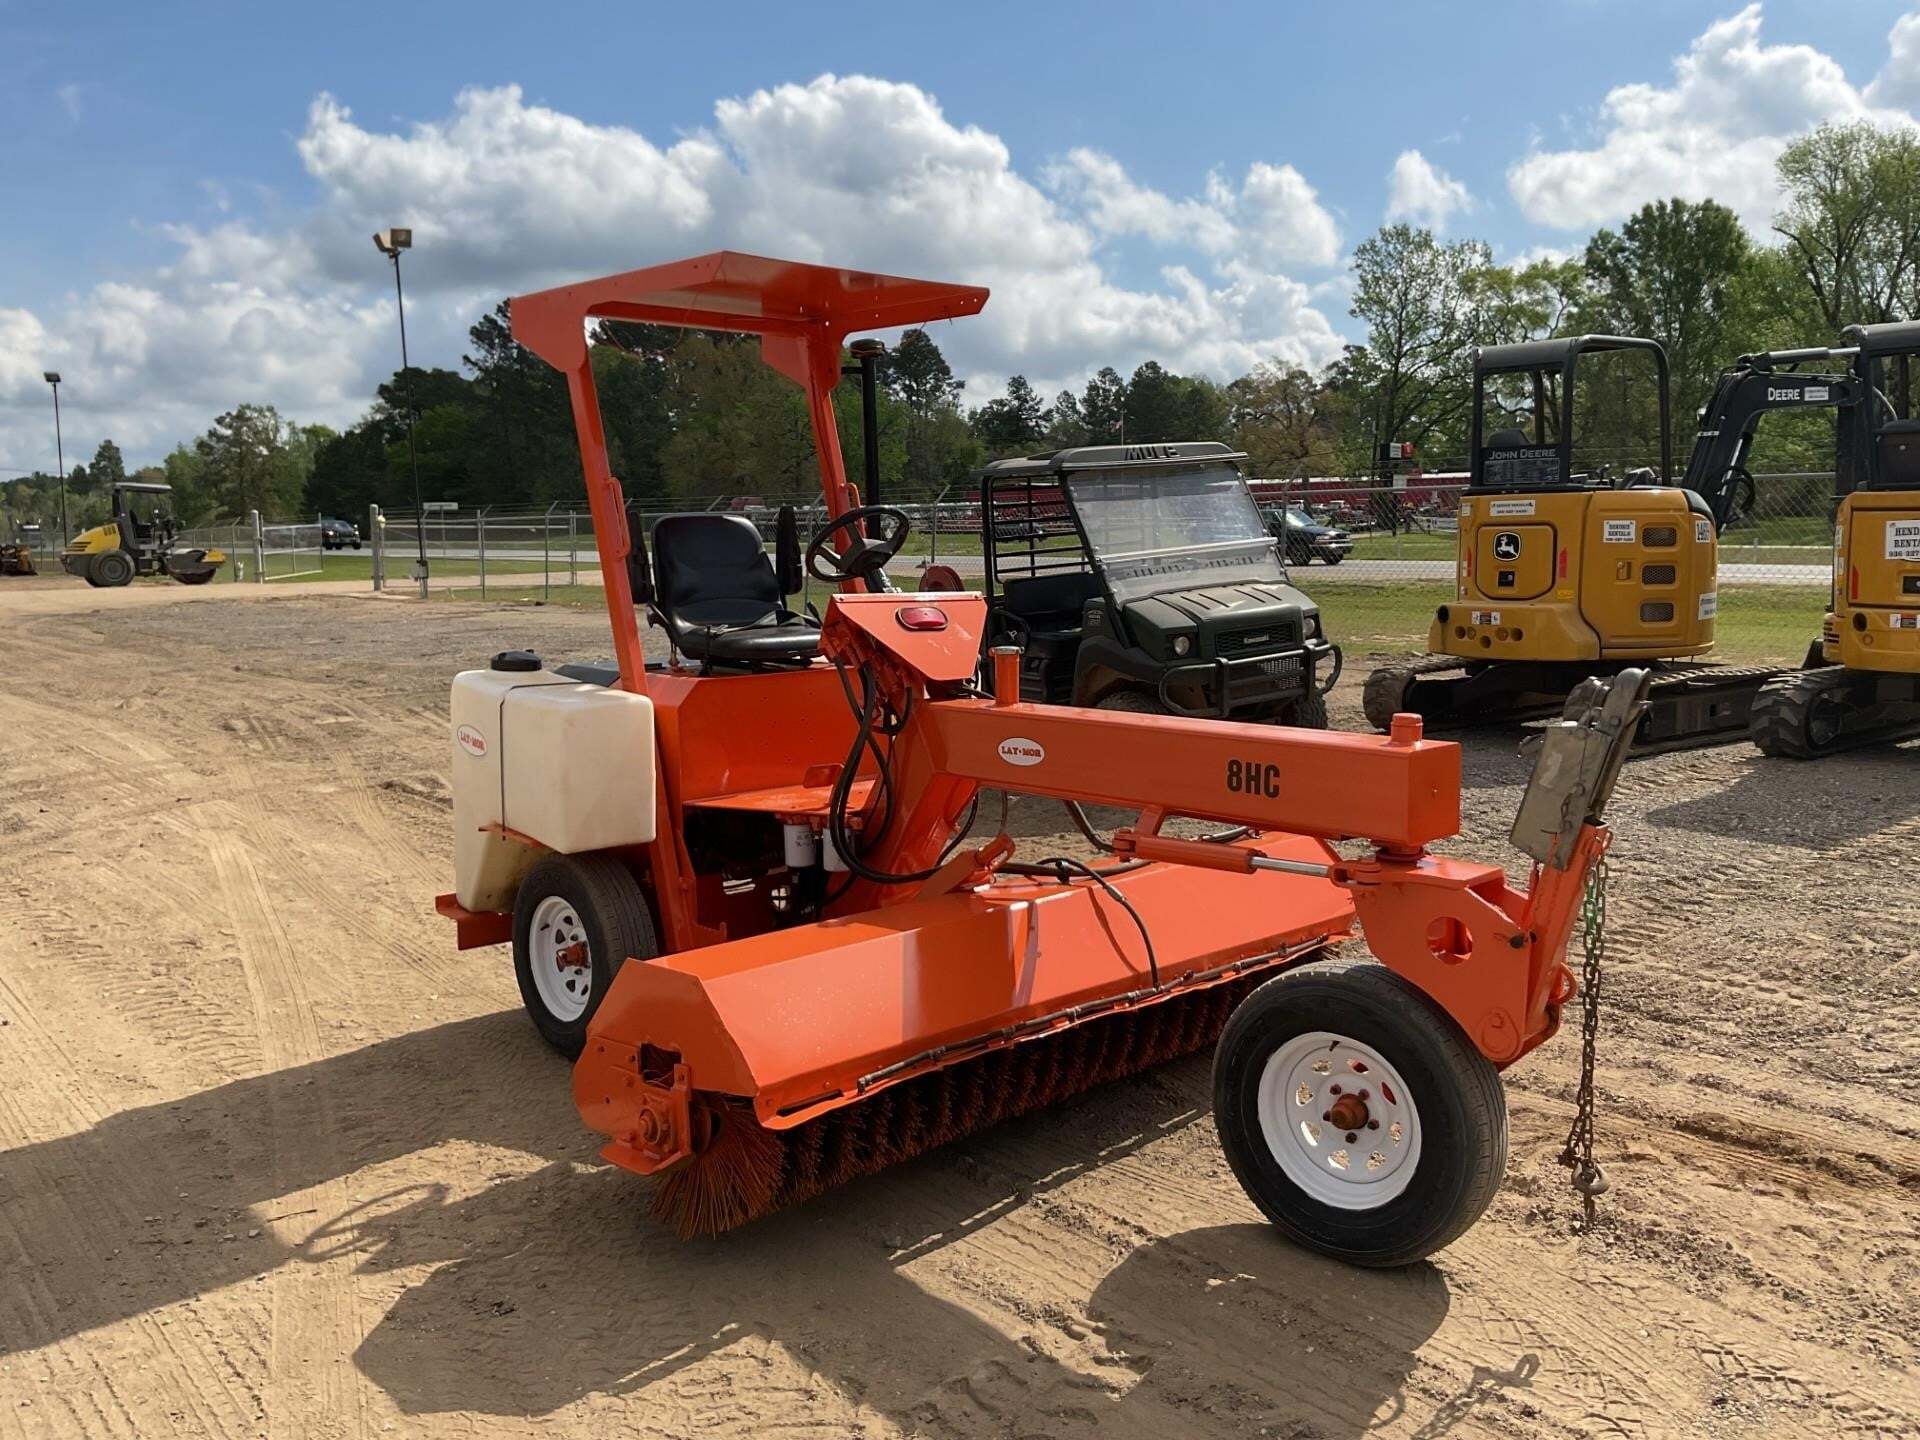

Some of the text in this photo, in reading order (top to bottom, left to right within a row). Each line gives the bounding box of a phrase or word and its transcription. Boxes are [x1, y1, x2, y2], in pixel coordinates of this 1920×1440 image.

[1767, 387, 1801, 402] DEERE
[1125, 445, 1180, 461] MULE
[1489, 448, 1556, 461] JOHN DEERE
[1226, 759, 1281, 798] 8HC
